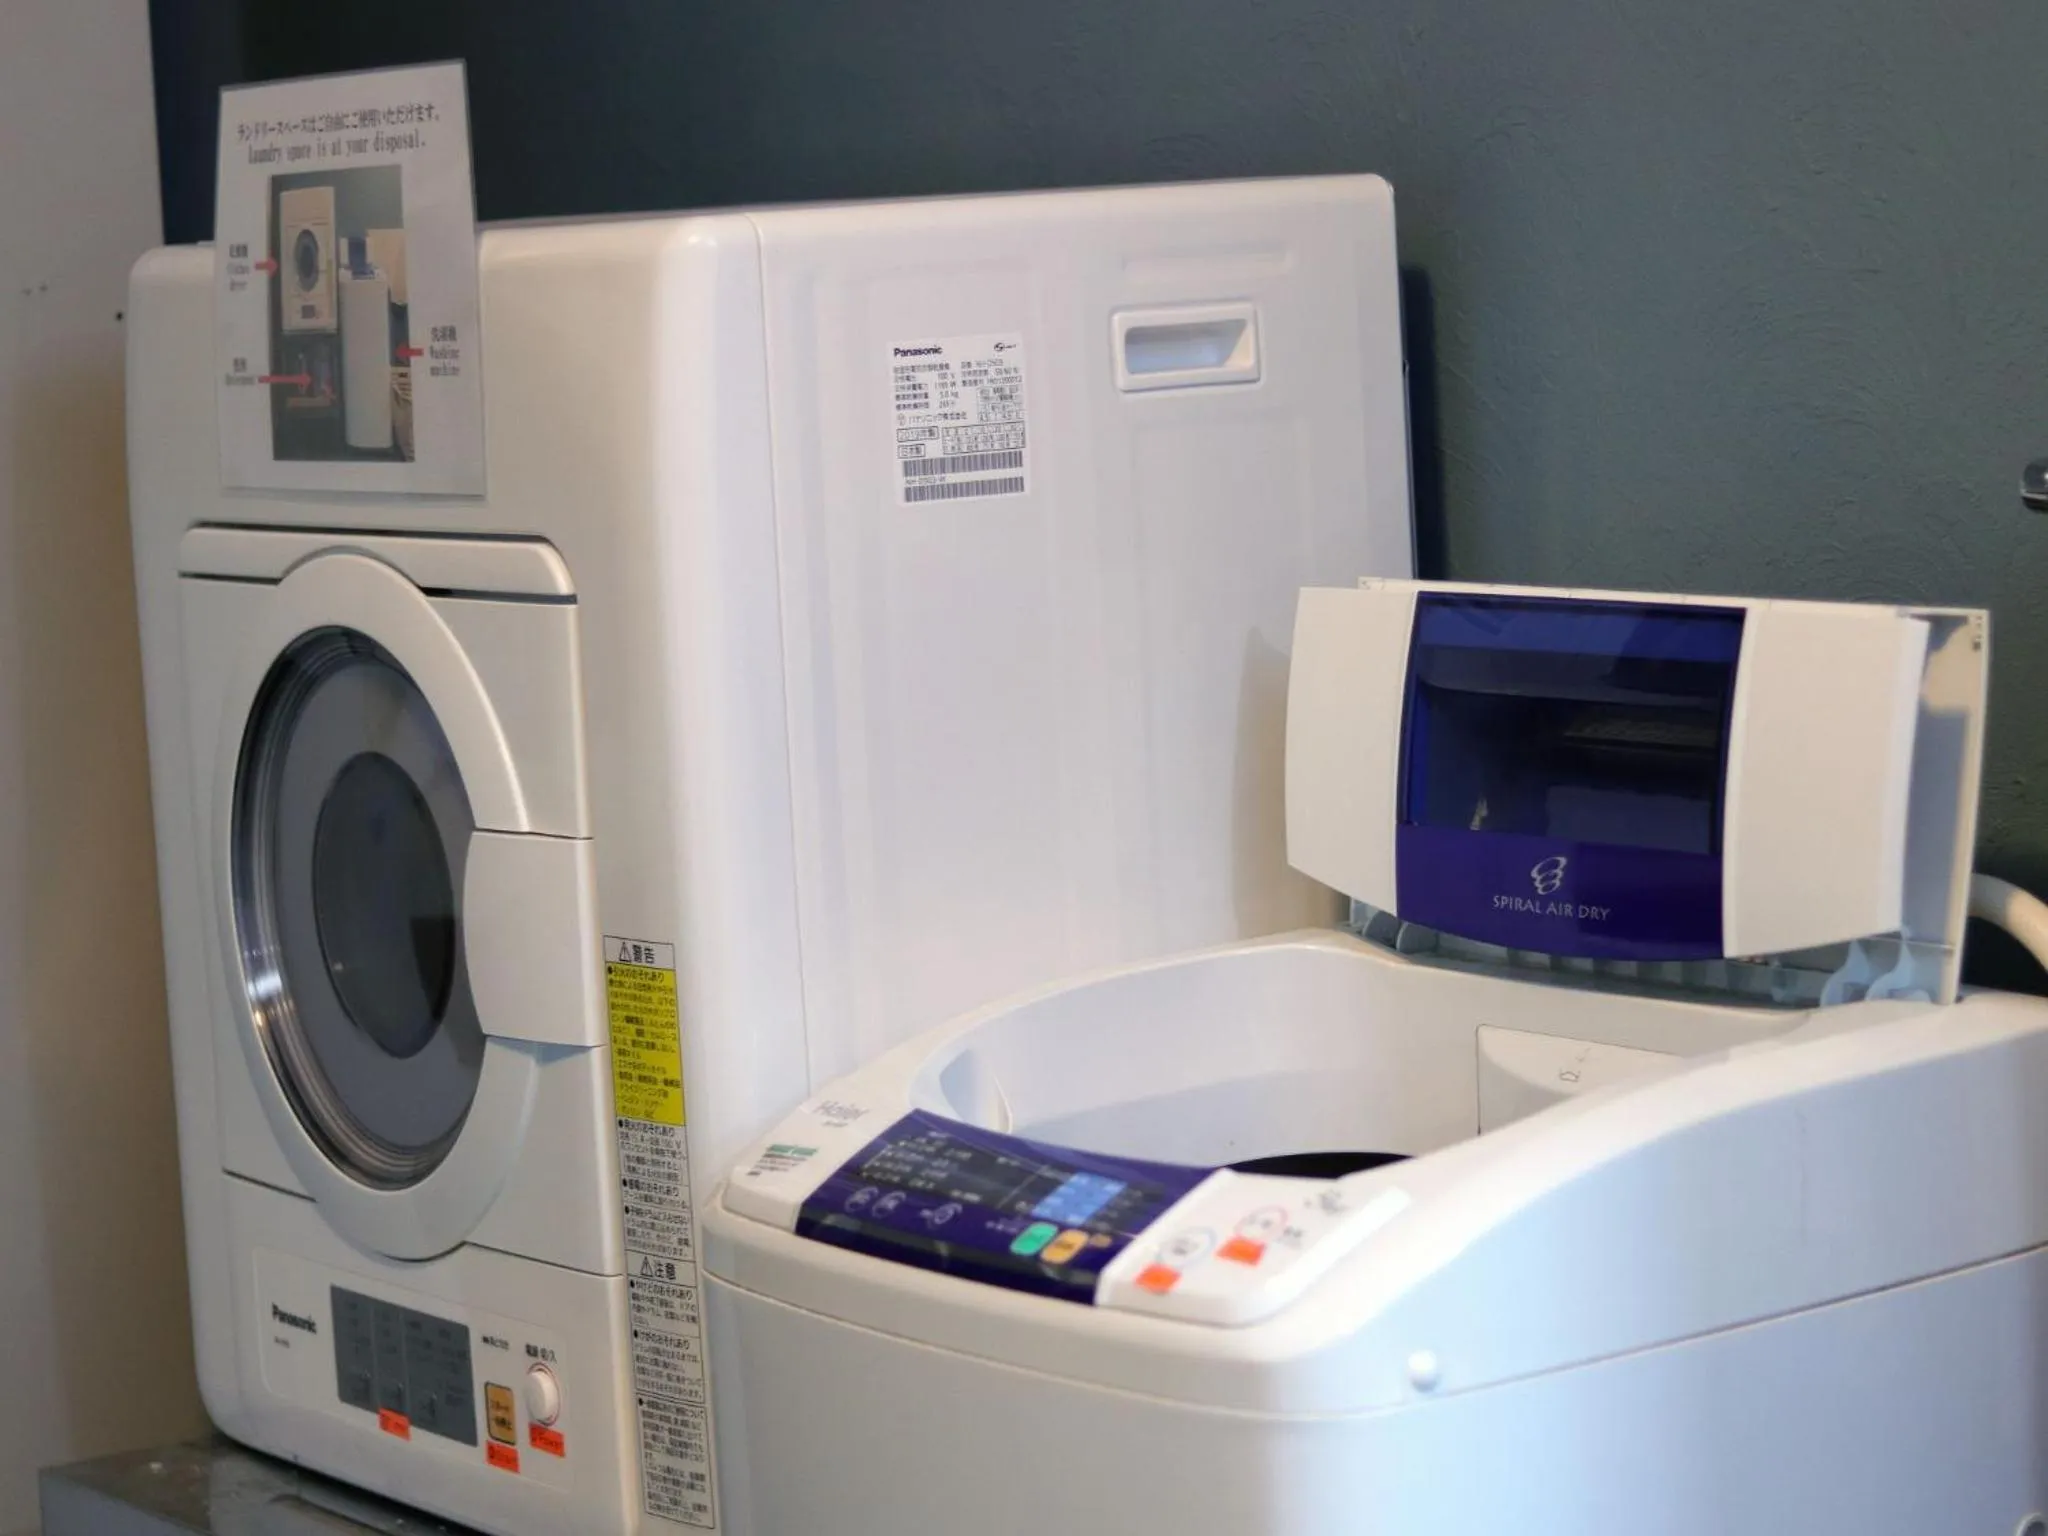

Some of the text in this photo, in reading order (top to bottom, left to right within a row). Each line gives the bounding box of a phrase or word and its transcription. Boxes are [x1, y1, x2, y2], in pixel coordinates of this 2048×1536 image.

[893, 344, 943, 358] Panasonic
[1492, 895, 1612, 921] SPIRAL AIR DRY
[632, 943, 655, 964] 警告
[653, 1260, 676, 1280] 注意
[271, 1301, 318, 1335] Panasonic
